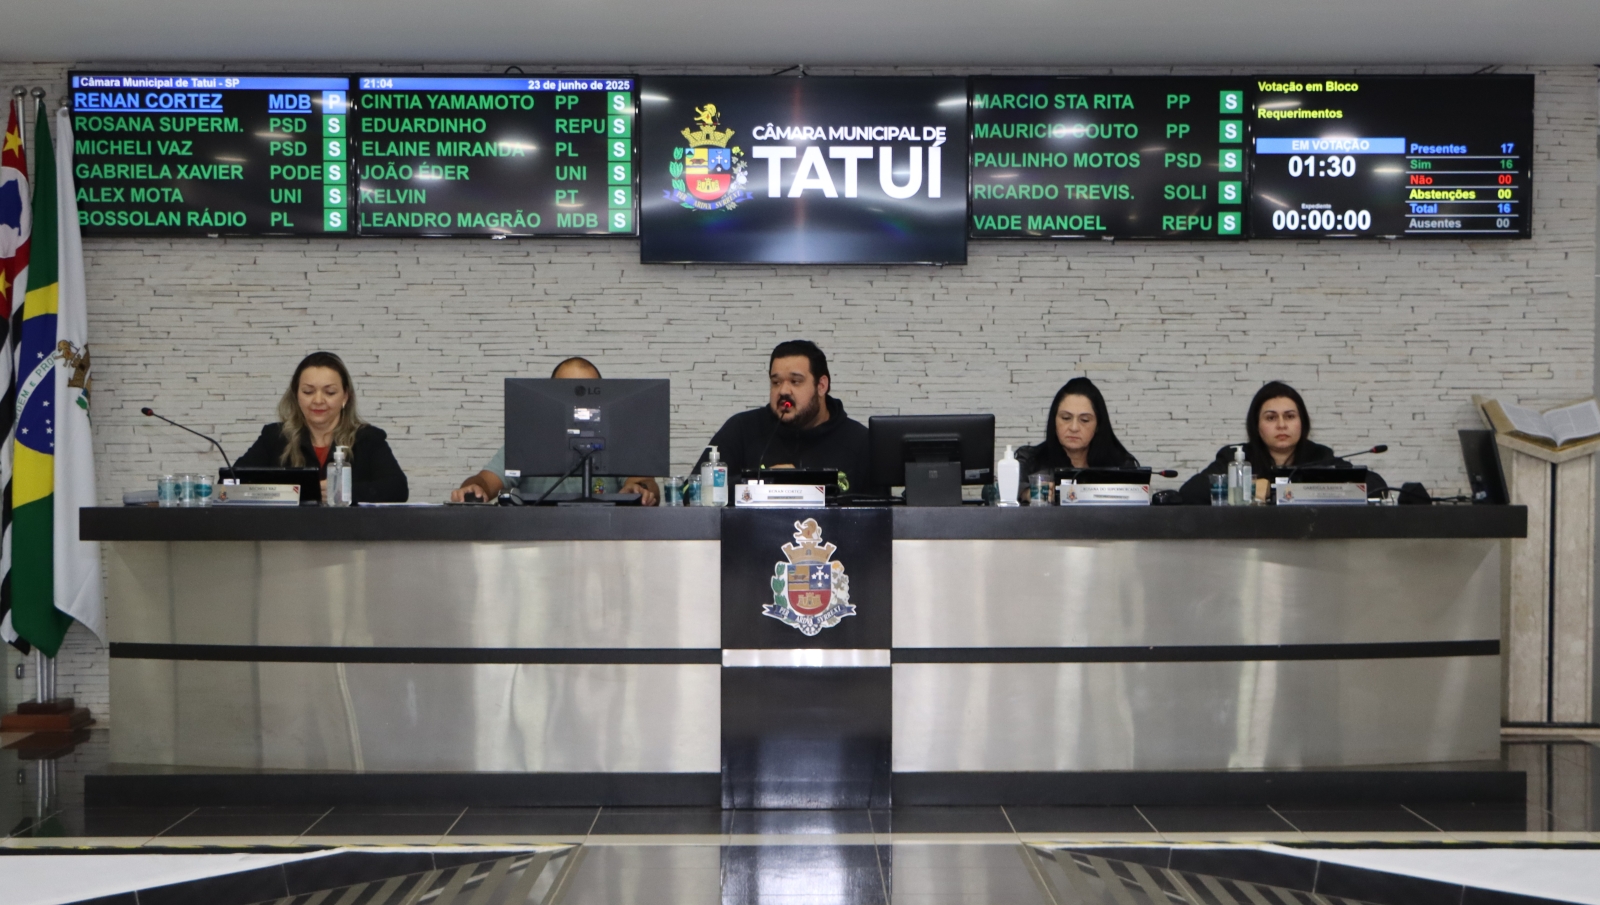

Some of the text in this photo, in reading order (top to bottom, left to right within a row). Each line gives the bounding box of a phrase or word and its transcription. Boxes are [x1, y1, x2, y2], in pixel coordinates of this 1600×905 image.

[80, 77, 121, 87] Câmara
[123, 78, 173, 89] Municipal
[176, 78, 188, 87] de
[191, 78, 216, 88] Tatuí
[225, 79, 240, 88] SP
[363, 79, 393, 89] 21:04
[528, 81, 630, 91] 23 de junho de 2025
[1258, 82, 1358, 93] Votação em Bloco
[74, 93, 340, 109] RENAN CORTEZ MDB P
[361, 94, 625, 110] CINTIA YAMAMOTO PP S
[974, 94, 1237, 109] MARCIO STA RITA PP S
[1258, 109, 1343, 120] Requerimentos
[75, 117, 340, 133] ROSANA SUPERM. PSD S
[361, 118, 625, 134] EDUARDINHO REPU S
[752, 123, 946, 141] CÂMARA MUNICIPAL DE
[974, 124, 1237, 139] MAURICIO COUTO PP S
[75, 141, 340, 157] MICHELI VAZ PSD S
[362, 142, 625, 158] ELAINE MIRANDA PL S
[1292, 139, 1370, 151] EM VOTAÇÃO
[1410, 144, 1514, 154] Presentes 17
[974, 153, 1236, 168] PAULINHO MOTOS PSD S
[1288, 156, 1356, 177] 01:30
[1410, 159, 1513, 169] Sim 16
[76, 164, 341, 180] GABRIELA XAVIER PODE S
[360, 162, 626, 181] JOÃO ÉDER UNI S
[753, 141, 946, 198] TATUÍ
[1410, 175, 1512, 185] Não 00
[76, 188, 341, 204] ALEX MOTA UNI S
[360, 189, 626, 205] KELVIN PT S
[974, 185, 1236, 200] RICARDO TREVIS. SOLI S
[1409, 189, 1511, 202] Abstenções 00
[1410, 203, 1511, 214] Total 16
[79, 209, 342, 228] BOSSOLAN RÁDIO PL S
[360, 210, 626, 229] LEANDRO MAGRÃO MDB S
[974, 215, 1236, 231] VADE MANOEL REPU S
[1272, 210, 1371, 230] 00:00:00
[1409, 219, 1510, 229] Ausentes 00
[588, 386, 600, 394] LG
